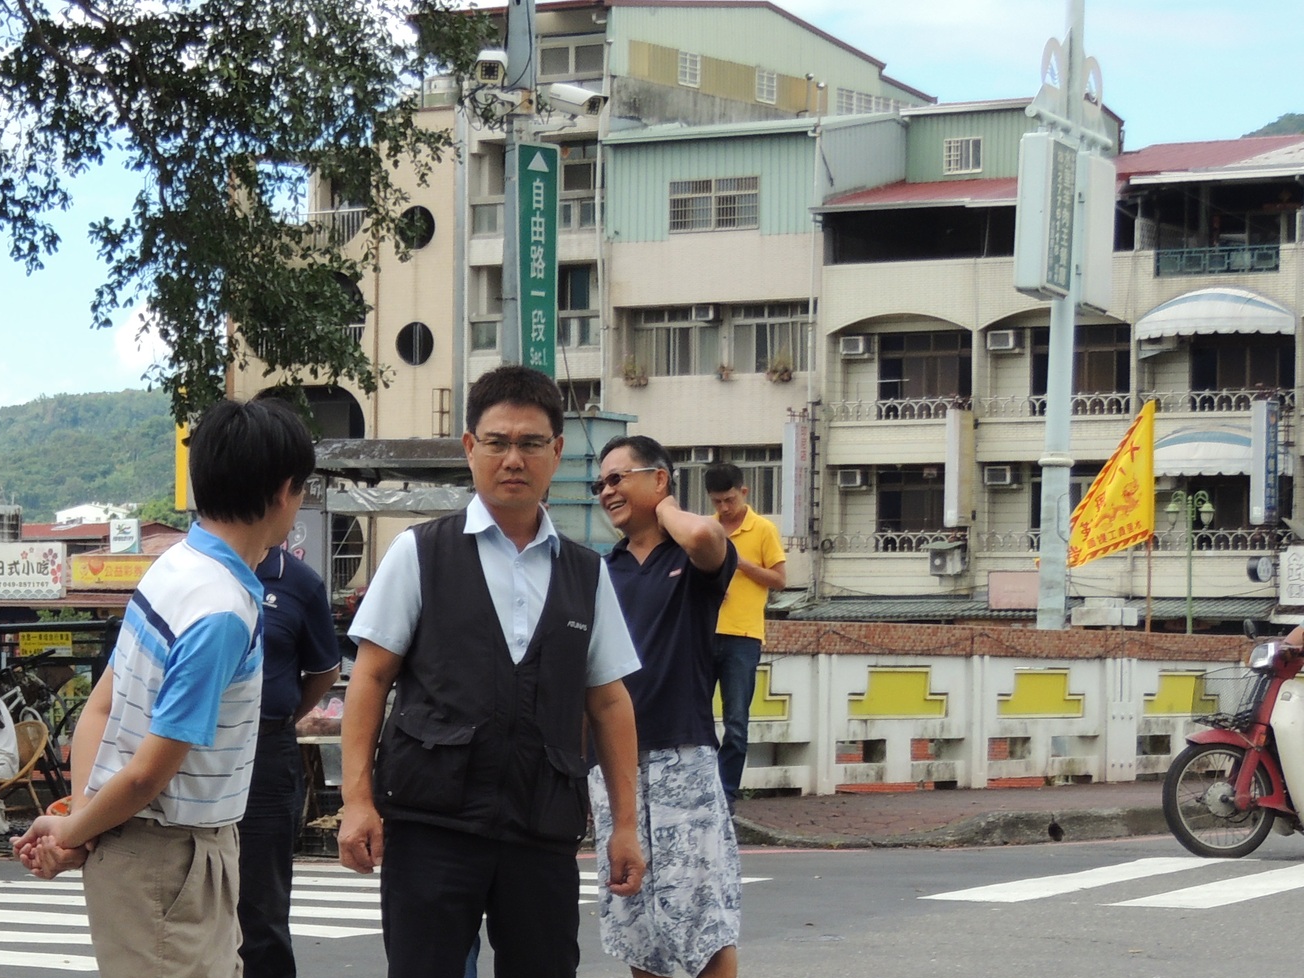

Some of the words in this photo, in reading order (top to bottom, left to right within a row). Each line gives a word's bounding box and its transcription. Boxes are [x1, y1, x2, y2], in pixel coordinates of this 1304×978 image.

[530, 177, 546, 342] 自由路一段
